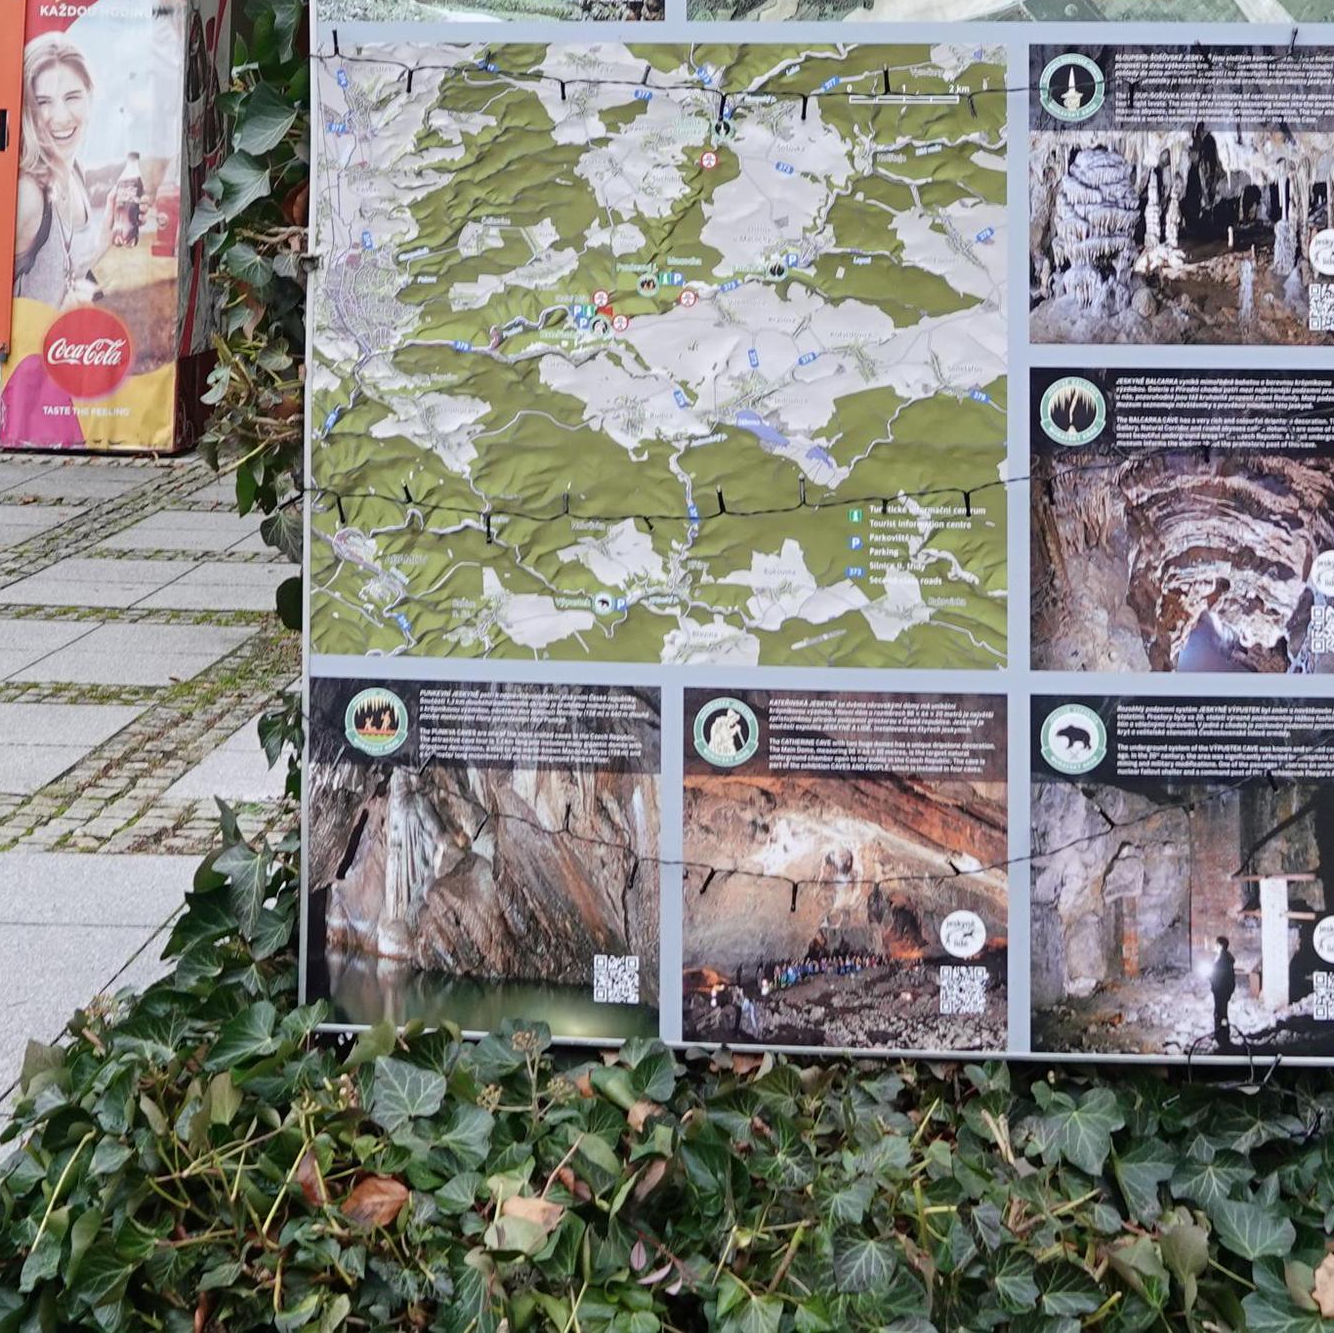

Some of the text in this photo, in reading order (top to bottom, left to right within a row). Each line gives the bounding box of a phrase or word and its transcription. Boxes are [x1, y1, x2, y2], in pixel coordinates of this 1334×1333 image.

[40, 3, 102, 17] KAŽDOU
[847, 84, 970, 93] 0 1 2 km
[48, 338, 127, 366] Coca-Cola
[43, 406, 130, 416] TASTE THE FEELING
[870, 519, 971, 529] Tourist centre
